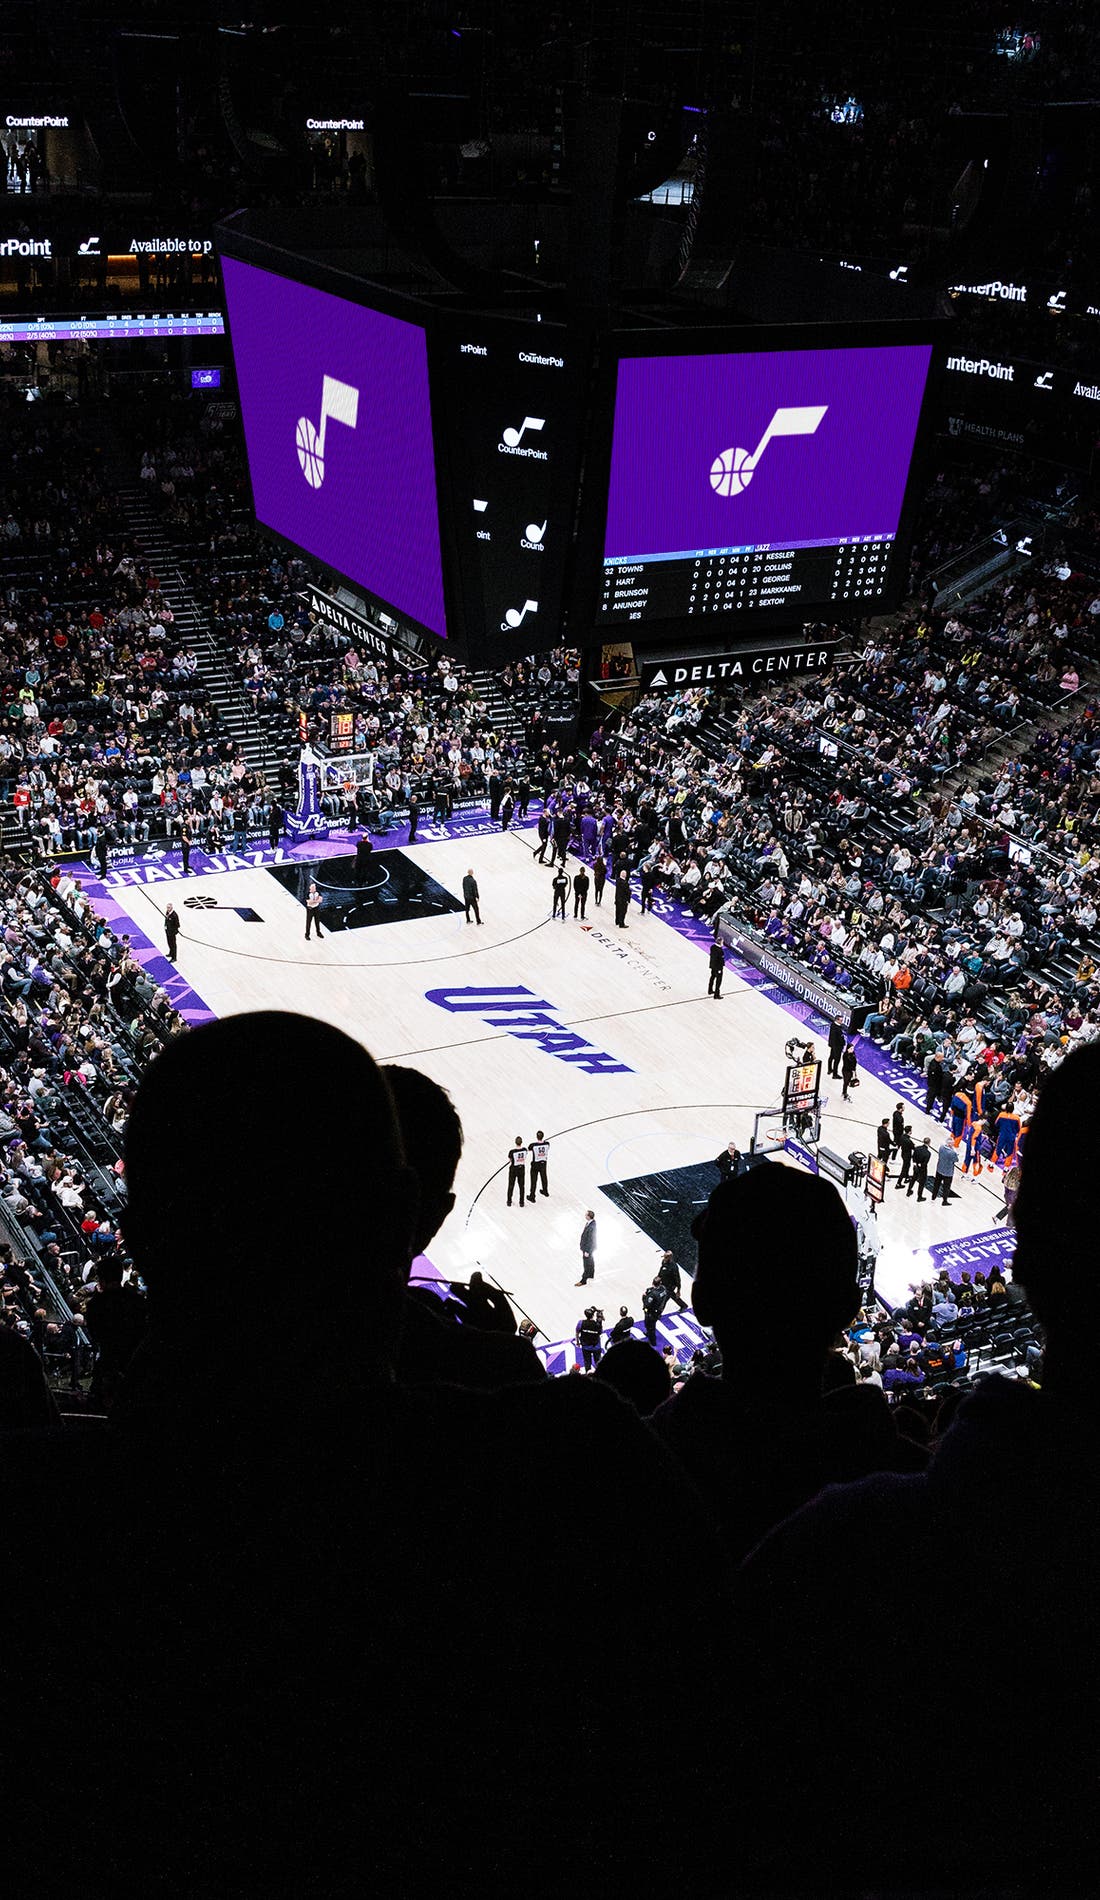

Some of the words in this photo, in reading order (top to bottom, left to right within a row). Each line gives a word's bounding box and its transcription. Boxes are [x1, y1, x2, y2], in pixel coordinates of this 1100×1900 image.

[6, 116, 69, 127] CounterPoint
[306, 118, 364, 129] CounterPoint
[128, 238, 186, 252] Available
[188, 238, 201, 251] to
[964, 422, 996, 438] HEALTH
[998, 430, 1025, 444] PLANS
[498, 443, 548, 460] CounterPoint
[766, 551, 795, 560] KESSLER
[604, 557, 627, 566] KNICKS
[764, 563, 792, 571] COLLINS
[618, 565, 644, 574] TOWNS
[763, 575, 790, 583] GEORGE
[615, 588, 648, 598] BRUNSON
[761, 585, 801, 595] MARKKANEN
[613, 600, 647, 610] ANUNOBY
[759, 598, 785, 606] SEXTON
[320, 600, 350, 631] DELTA
[352, 622, 387, 656] CENTER
[675, 662, 743, 682] DELTA
[752, 651, 828, 673] CENTER
[101, 861, 197, 888] UTAH
[203, 848, 295, 874] JAZZ
[591, 932, 628, 959] DELTA
[627, 960, 672, 991] CENTER
[759, 954, 795, 988] Available
[794, 979, 804, 994] to
[804, 988, 841, 1019] purchase
[842, 1013, 850, 1027] in
[424, 985, 637, 1075] UTAH
